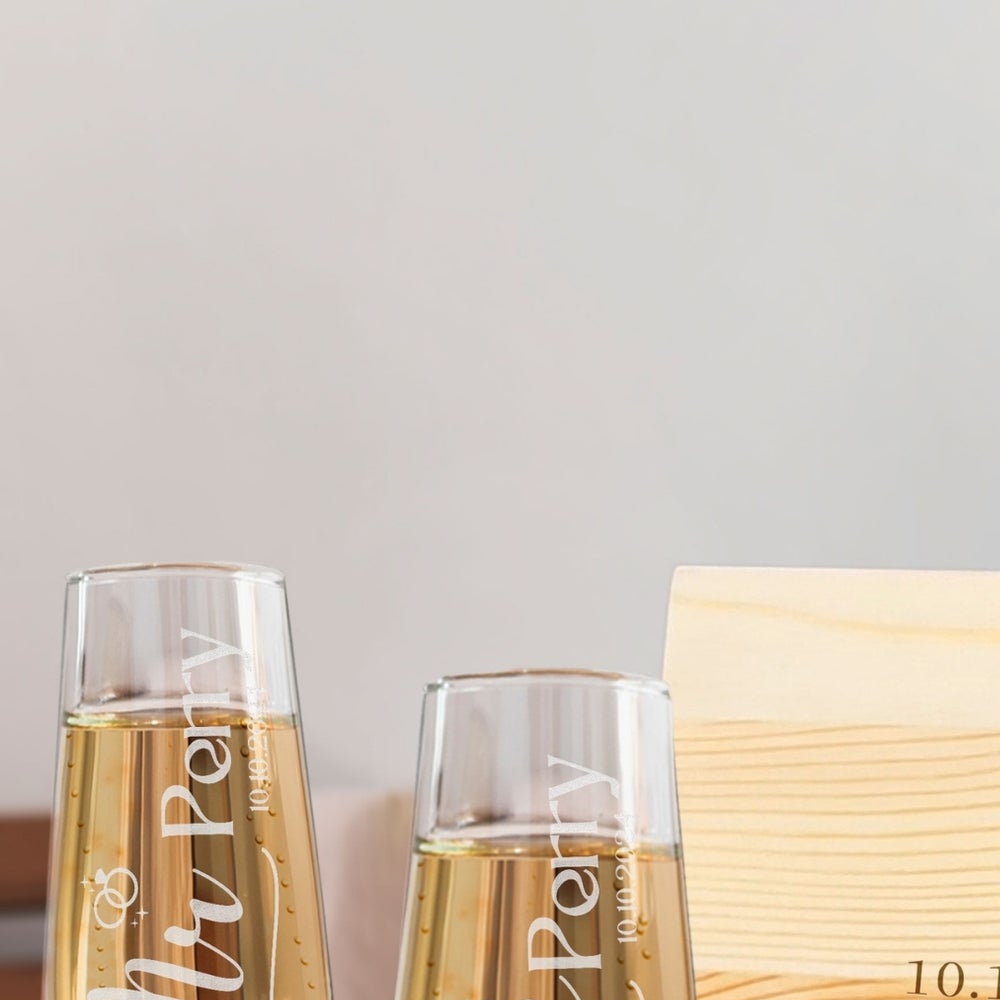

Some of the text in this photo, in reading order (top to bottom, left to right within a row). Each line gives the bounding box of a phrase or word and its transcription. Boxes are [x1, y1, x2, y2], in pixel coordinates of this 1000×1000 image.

[161, 627, 254, 838] Perry
[247, 687, 271, 812] 10.10.20
[528, 754, 622, 971] Perry
